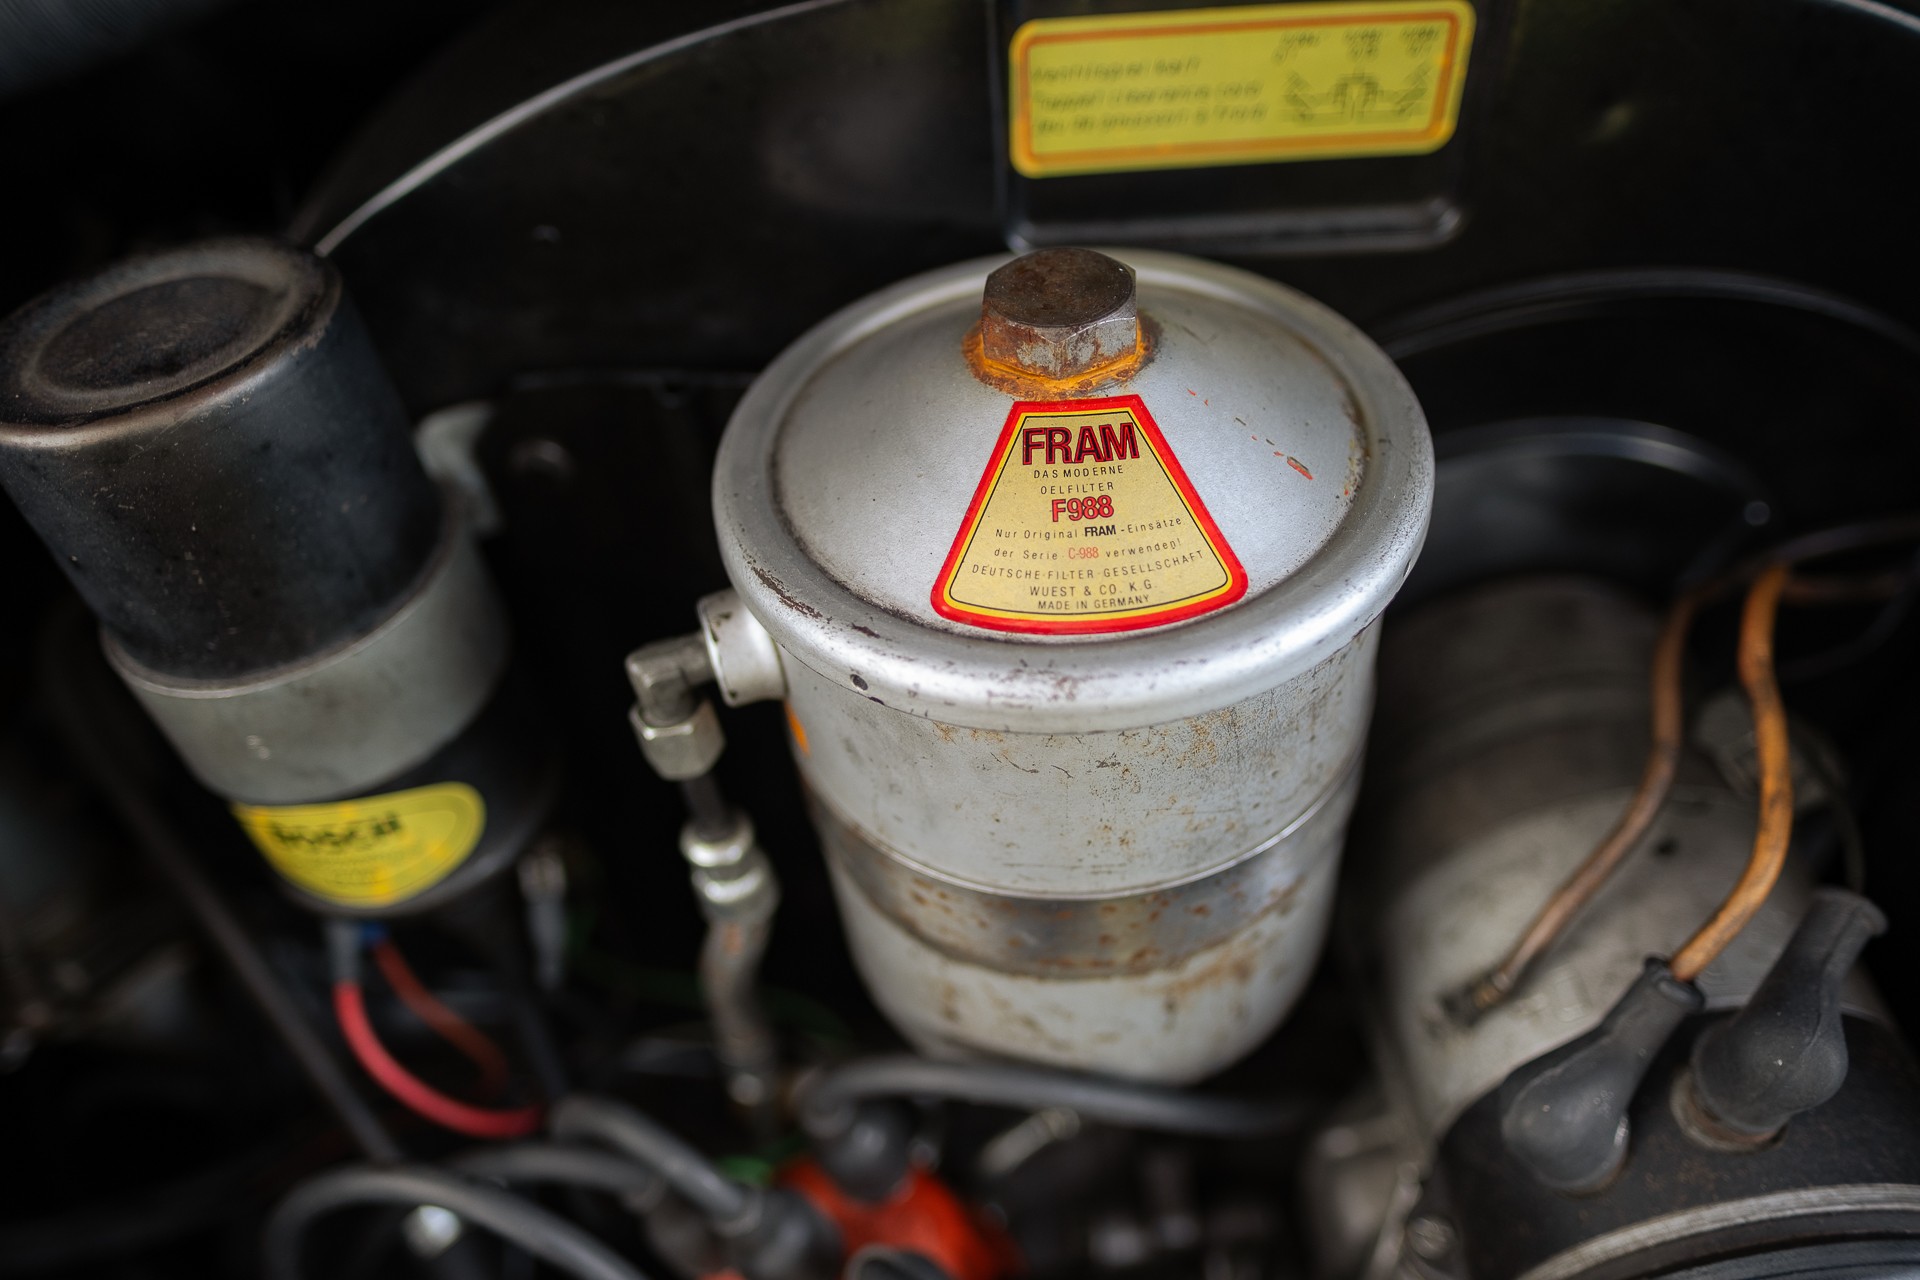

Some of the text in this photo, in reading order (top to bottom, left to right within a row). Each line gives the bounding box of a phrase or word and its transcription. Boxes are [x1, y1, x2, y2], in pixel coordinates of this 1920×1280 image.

[1022, 422, 1140, 465] FRAM
[1033, 465, 1124, 479] DAS MODERNE
[1040, 481, 1114, 495] OELFILTER
[1051, 494, 1114, 523] F988
[995, 528, 1017, 538] Nur
[1024, 529, 1078, 541] Original
[994, 538, 1182, 560] der Serie C-988 verwenden!
[972, 550, 1204, 580] DEUTSCHE FILTER GESELLSCHAFT
[1029, 586, 1076, 597] WUEST
[1083, 585, 1092, 596] &
[1037, 594, 1150, 610] MADE IN GERMANY
